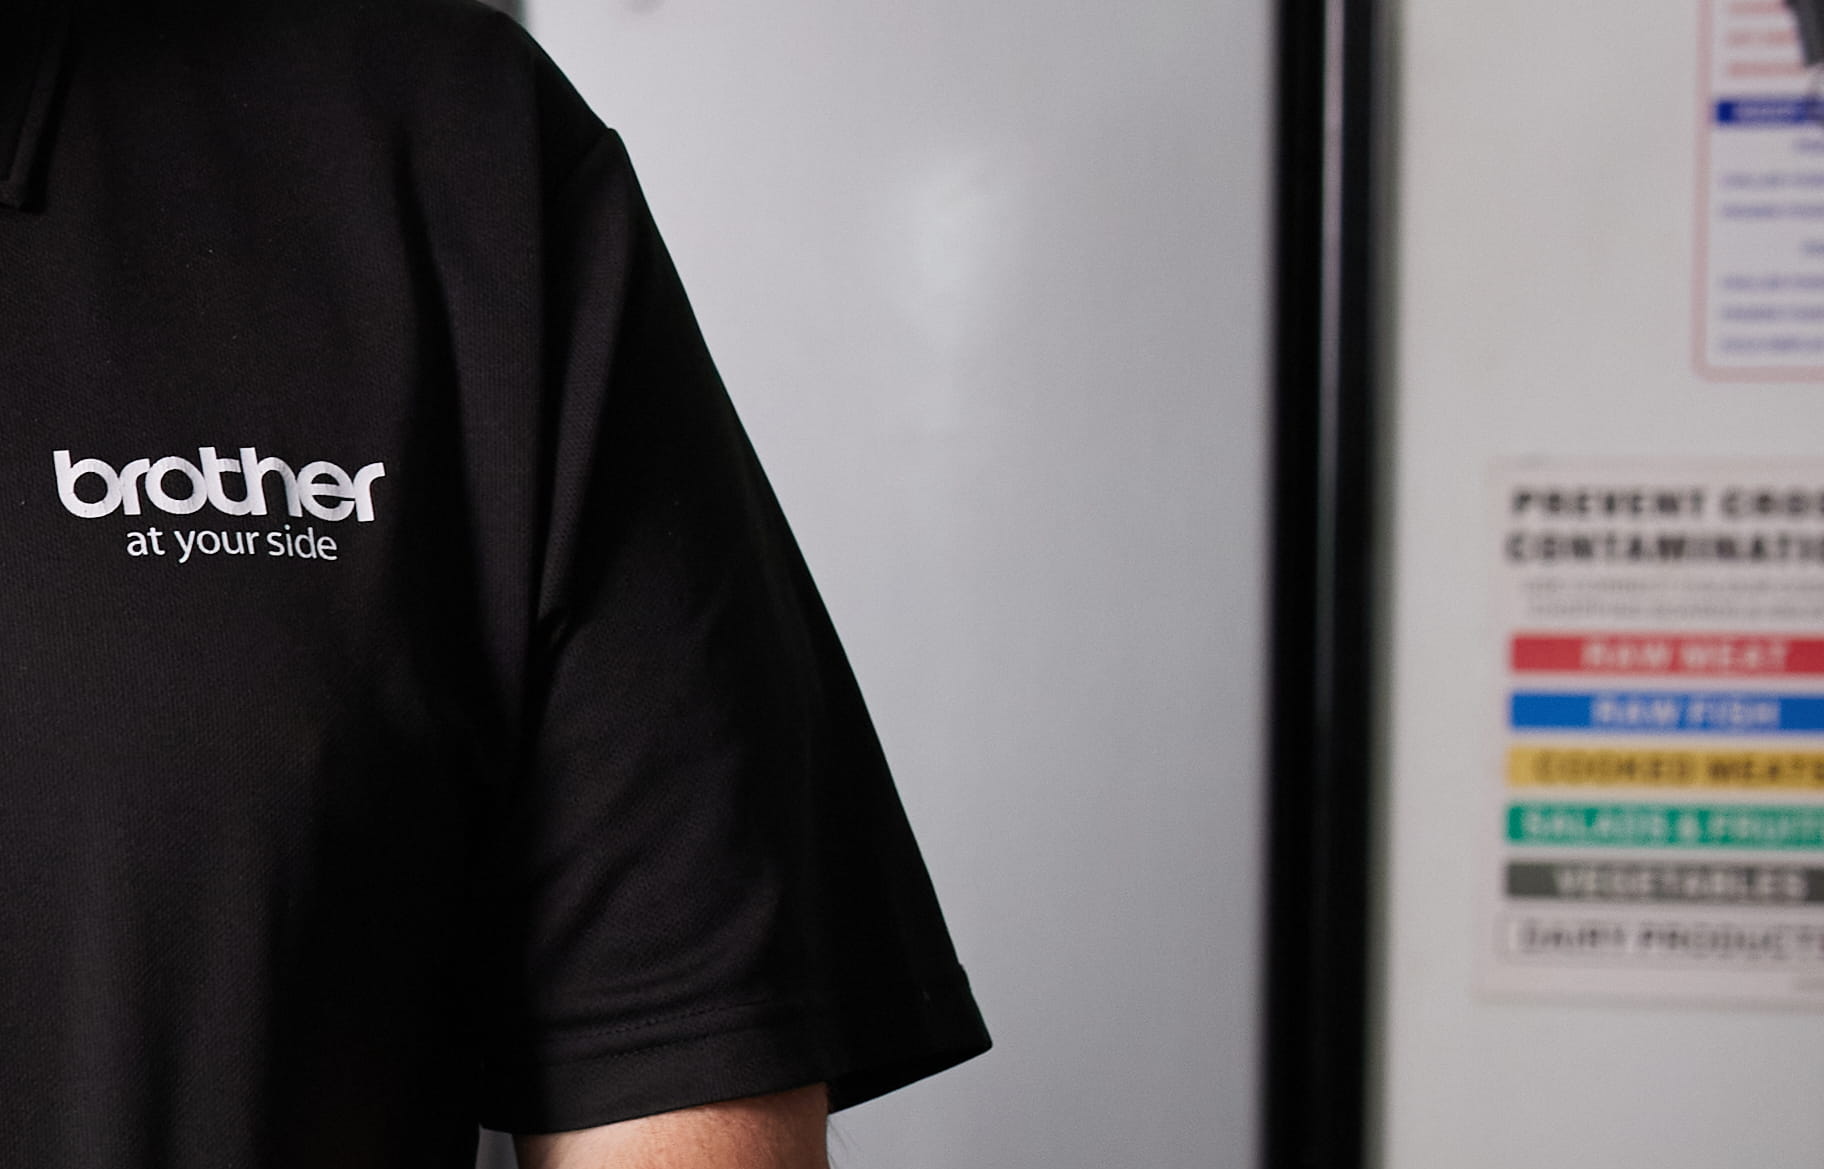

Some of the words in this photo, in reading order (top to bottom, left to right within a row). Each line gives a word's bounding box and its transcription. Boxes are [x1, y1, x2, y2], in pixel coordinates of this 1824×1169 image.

[53, 447, 385, 522] brother
[126, 527, 165, 556] at
[174, 530, 256, 563] your
[268, 525, 338, 560] side
